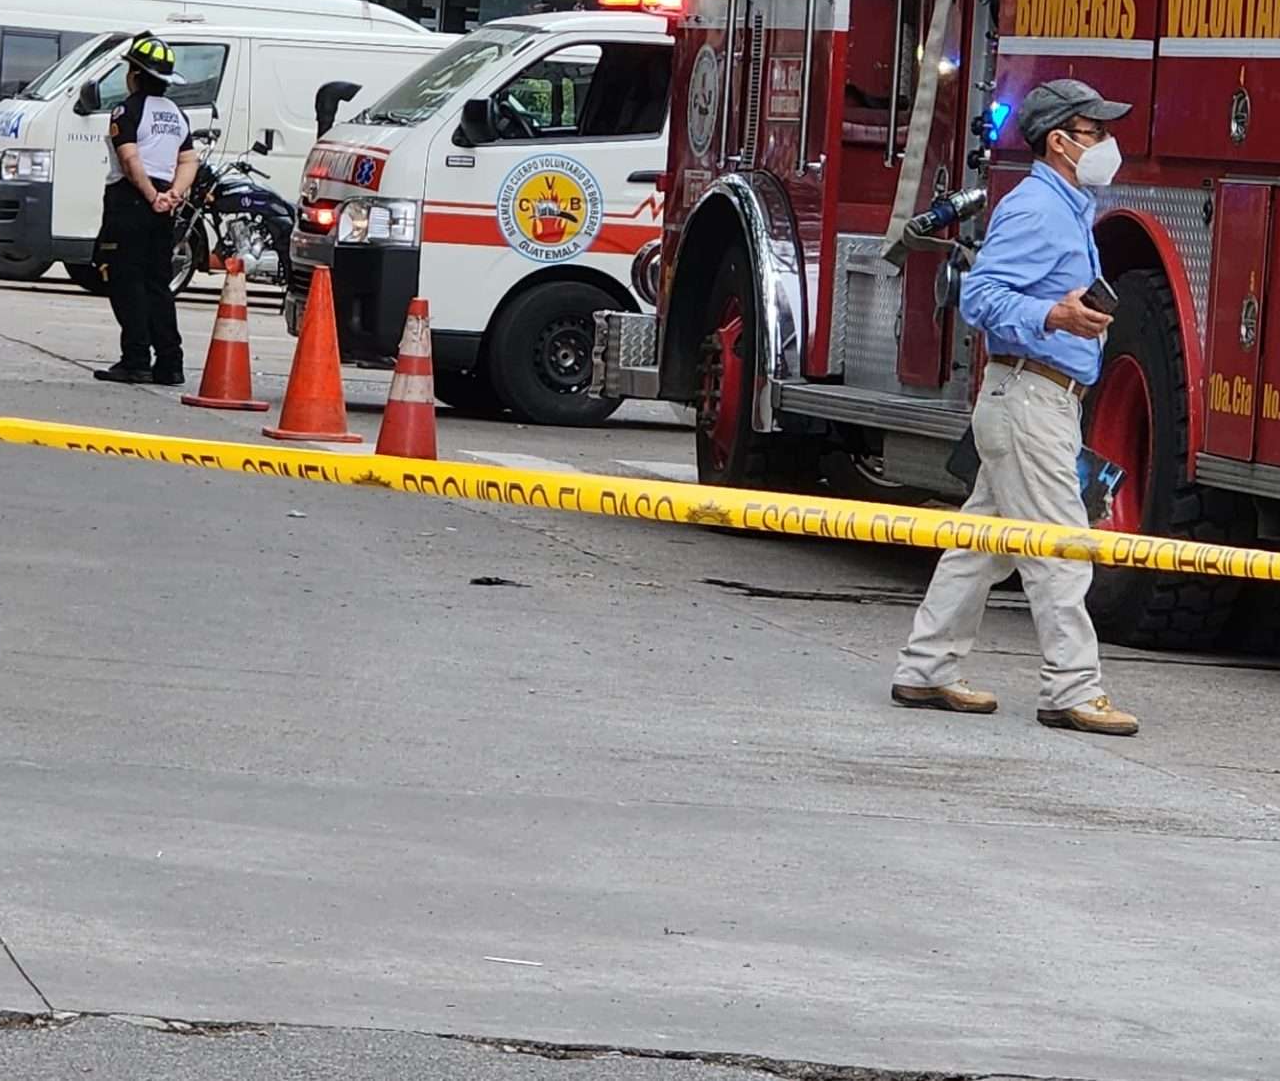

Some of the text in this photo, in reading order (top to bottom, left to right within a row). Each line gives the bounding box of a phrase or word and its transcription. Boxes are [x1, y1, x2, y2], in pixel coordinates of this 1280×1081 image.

[544, 176, 556, 190] V
[500, 157, 599, 238] BENEMERITO CUERPO VOLUNTARIO DE BOMBEROS
[570, 197, 582, 211] B
[518, 198, 530, 212] C
[518, 240, 581, 260] GUATEMALA
